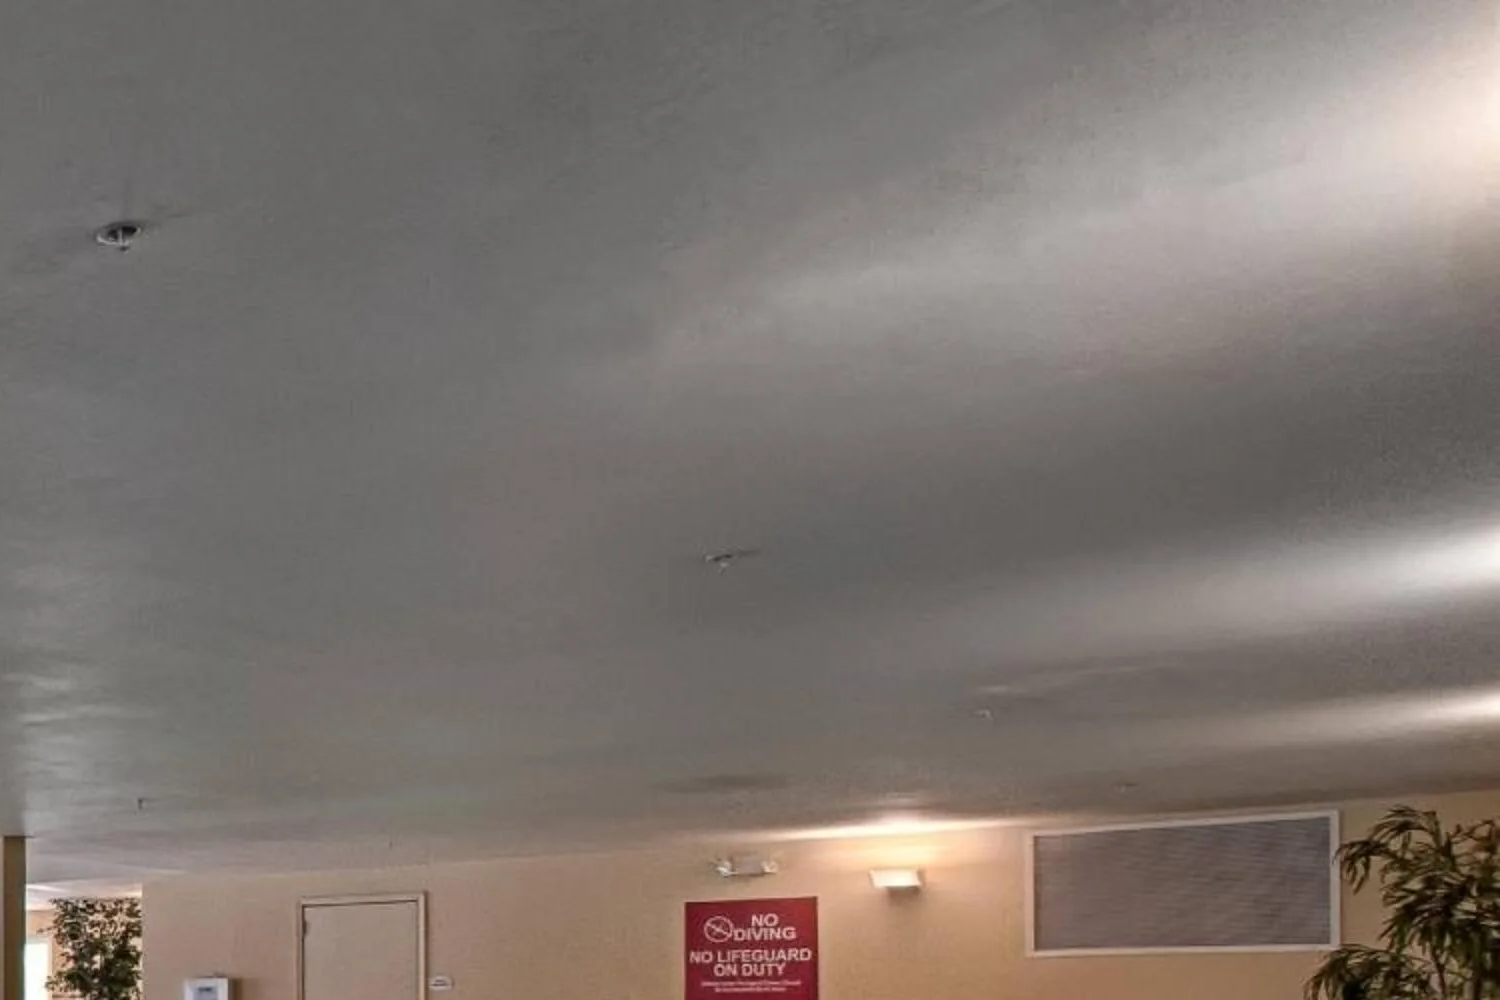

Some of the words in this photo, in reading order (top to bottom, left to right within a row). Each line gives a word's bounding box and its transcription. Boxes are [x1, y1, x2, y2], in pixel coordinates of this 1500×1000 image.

[750, 913, 779, 927] NO
[733, 926, 798, 941] DIVING
[689, 950, 714, 964] NO
[717, 947, 812, 963] LIFEGUARD
[713, 964, 738, 978] ON
[740, 963, 787, 977] DUTY
